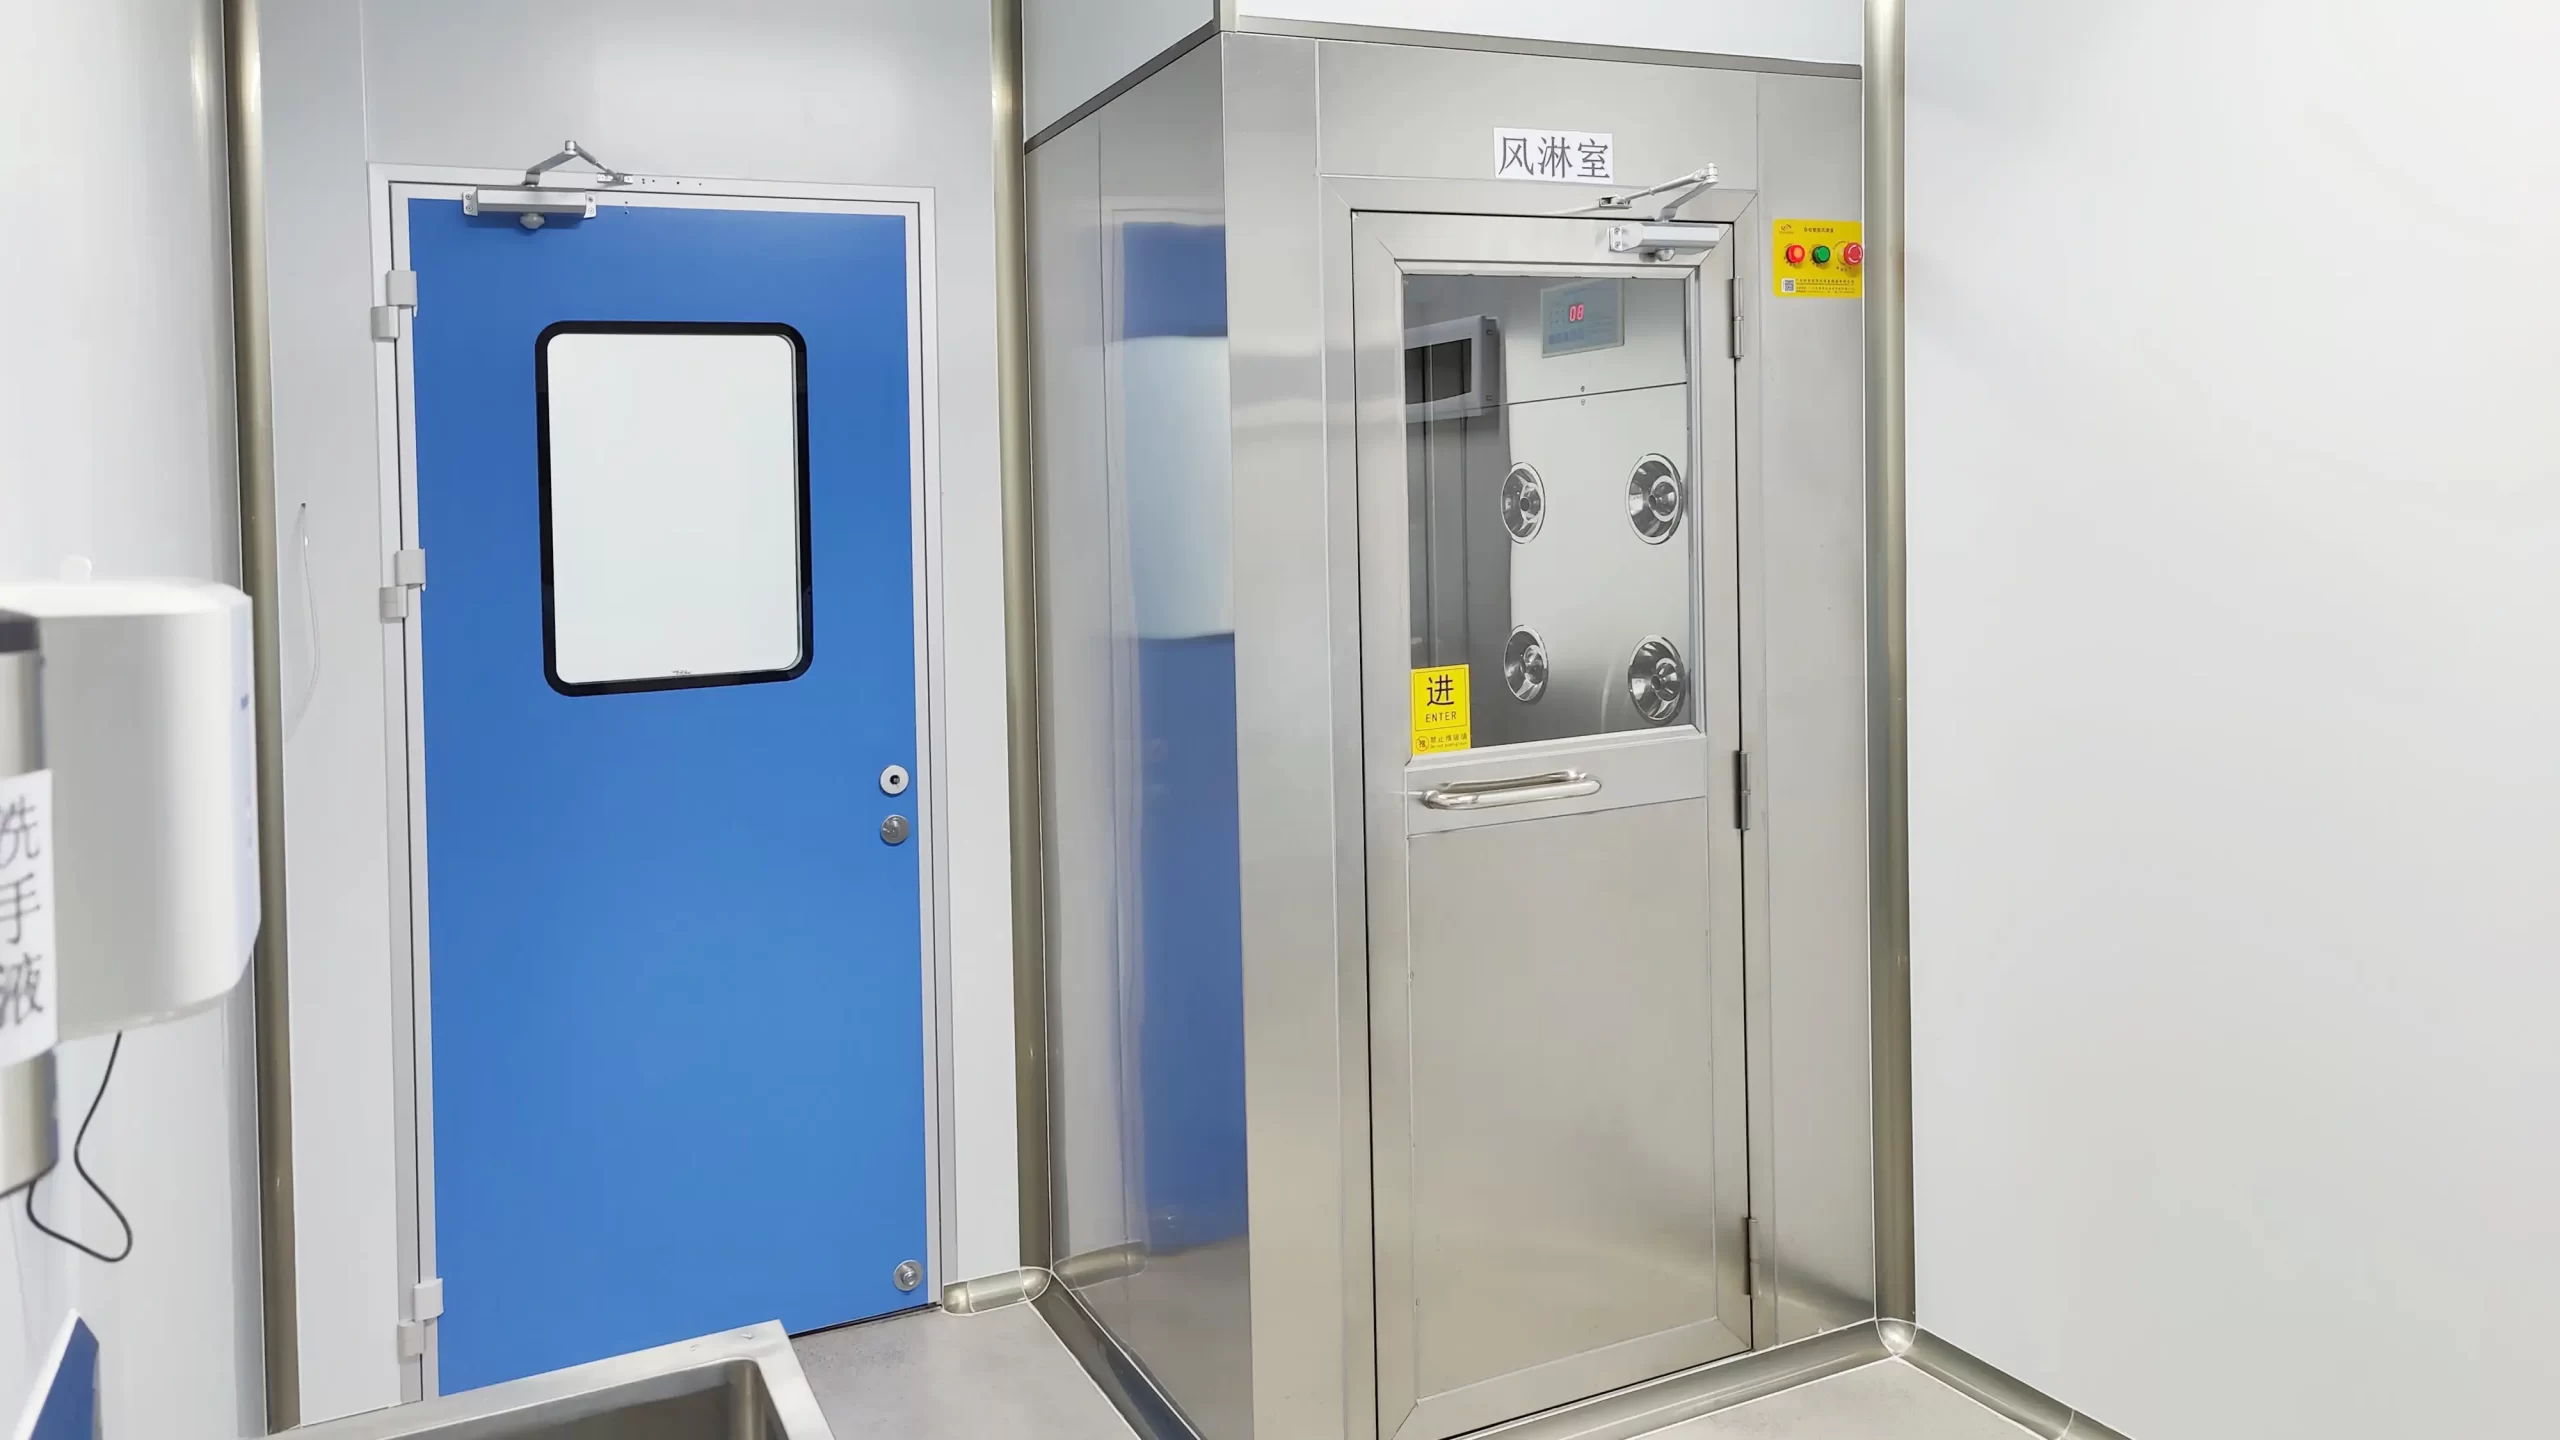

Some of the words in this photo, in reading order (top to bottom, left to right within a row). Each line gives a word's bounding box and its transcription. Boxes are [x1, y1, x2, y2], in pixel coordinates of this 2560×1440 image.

[1498, 136, 1611, 179] 风淋室
[1569, 304, 1584, 322] 08
[1426, 674, 1455, 706] 进
[1425, 711, 1457, 723] ENTER
